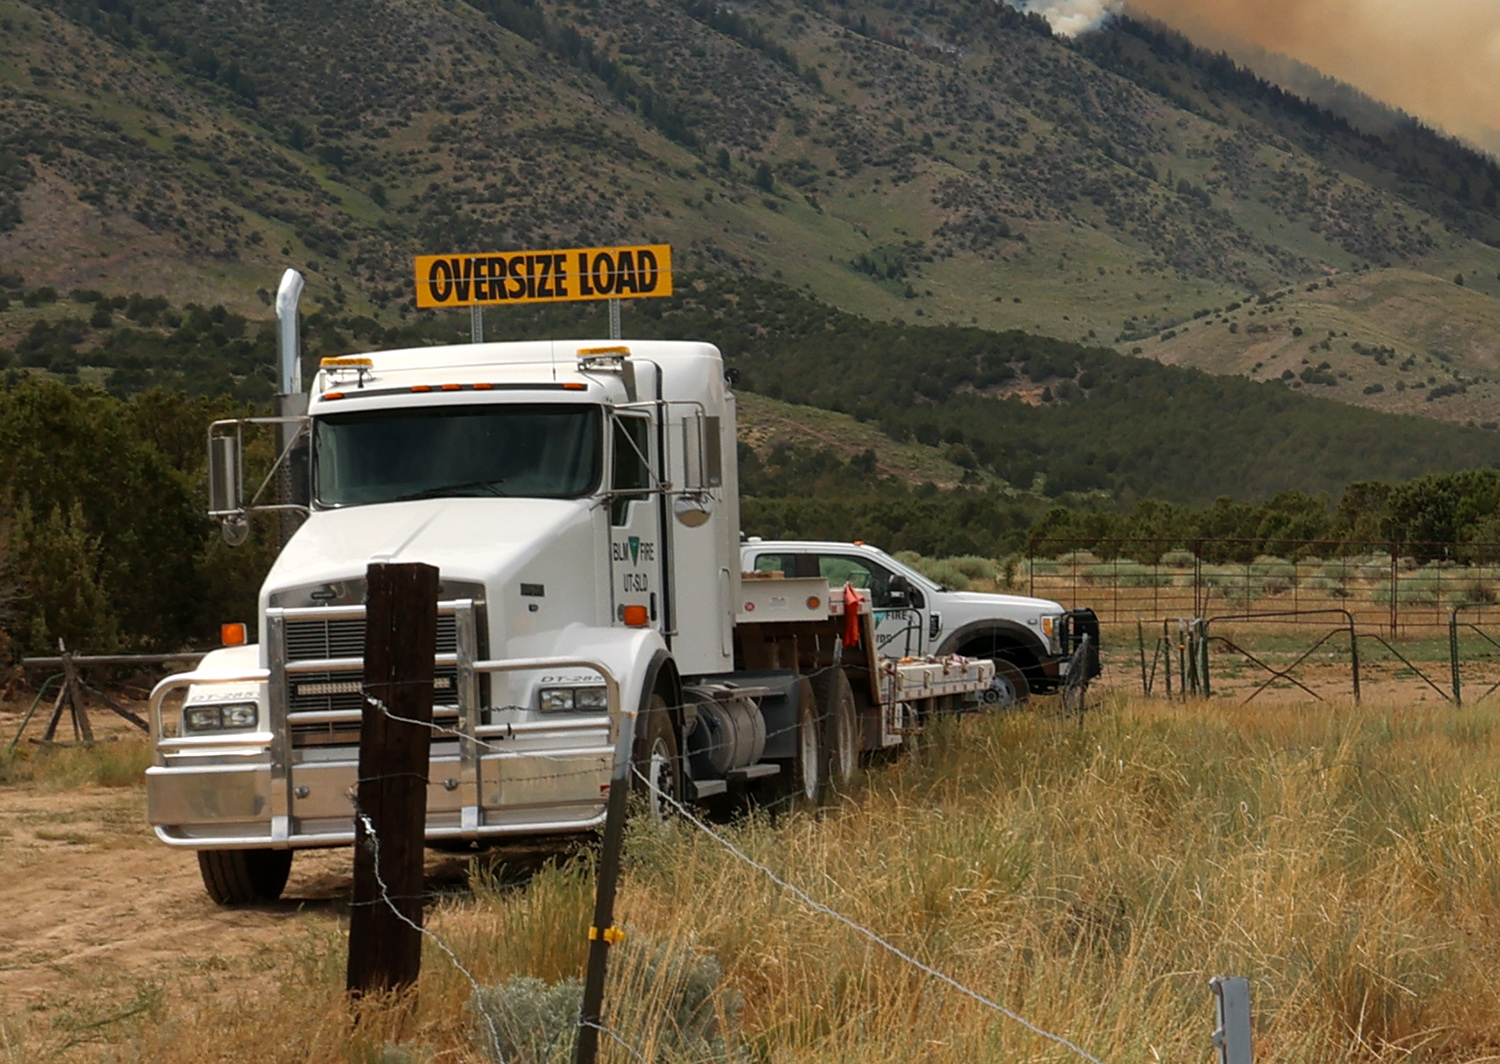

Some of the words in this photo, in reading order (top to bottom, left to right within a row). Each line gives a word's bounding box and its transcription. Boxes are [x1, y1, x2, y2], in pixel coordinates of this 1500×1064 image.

[429, 254, 569, 302] OVERSIZE
[579, 250, 659, 296] LOAD
[613, 542, 629, 561] BLM
[640, 542, 655, 561] FIRE
[885, 609, 908, 621] FIRE
